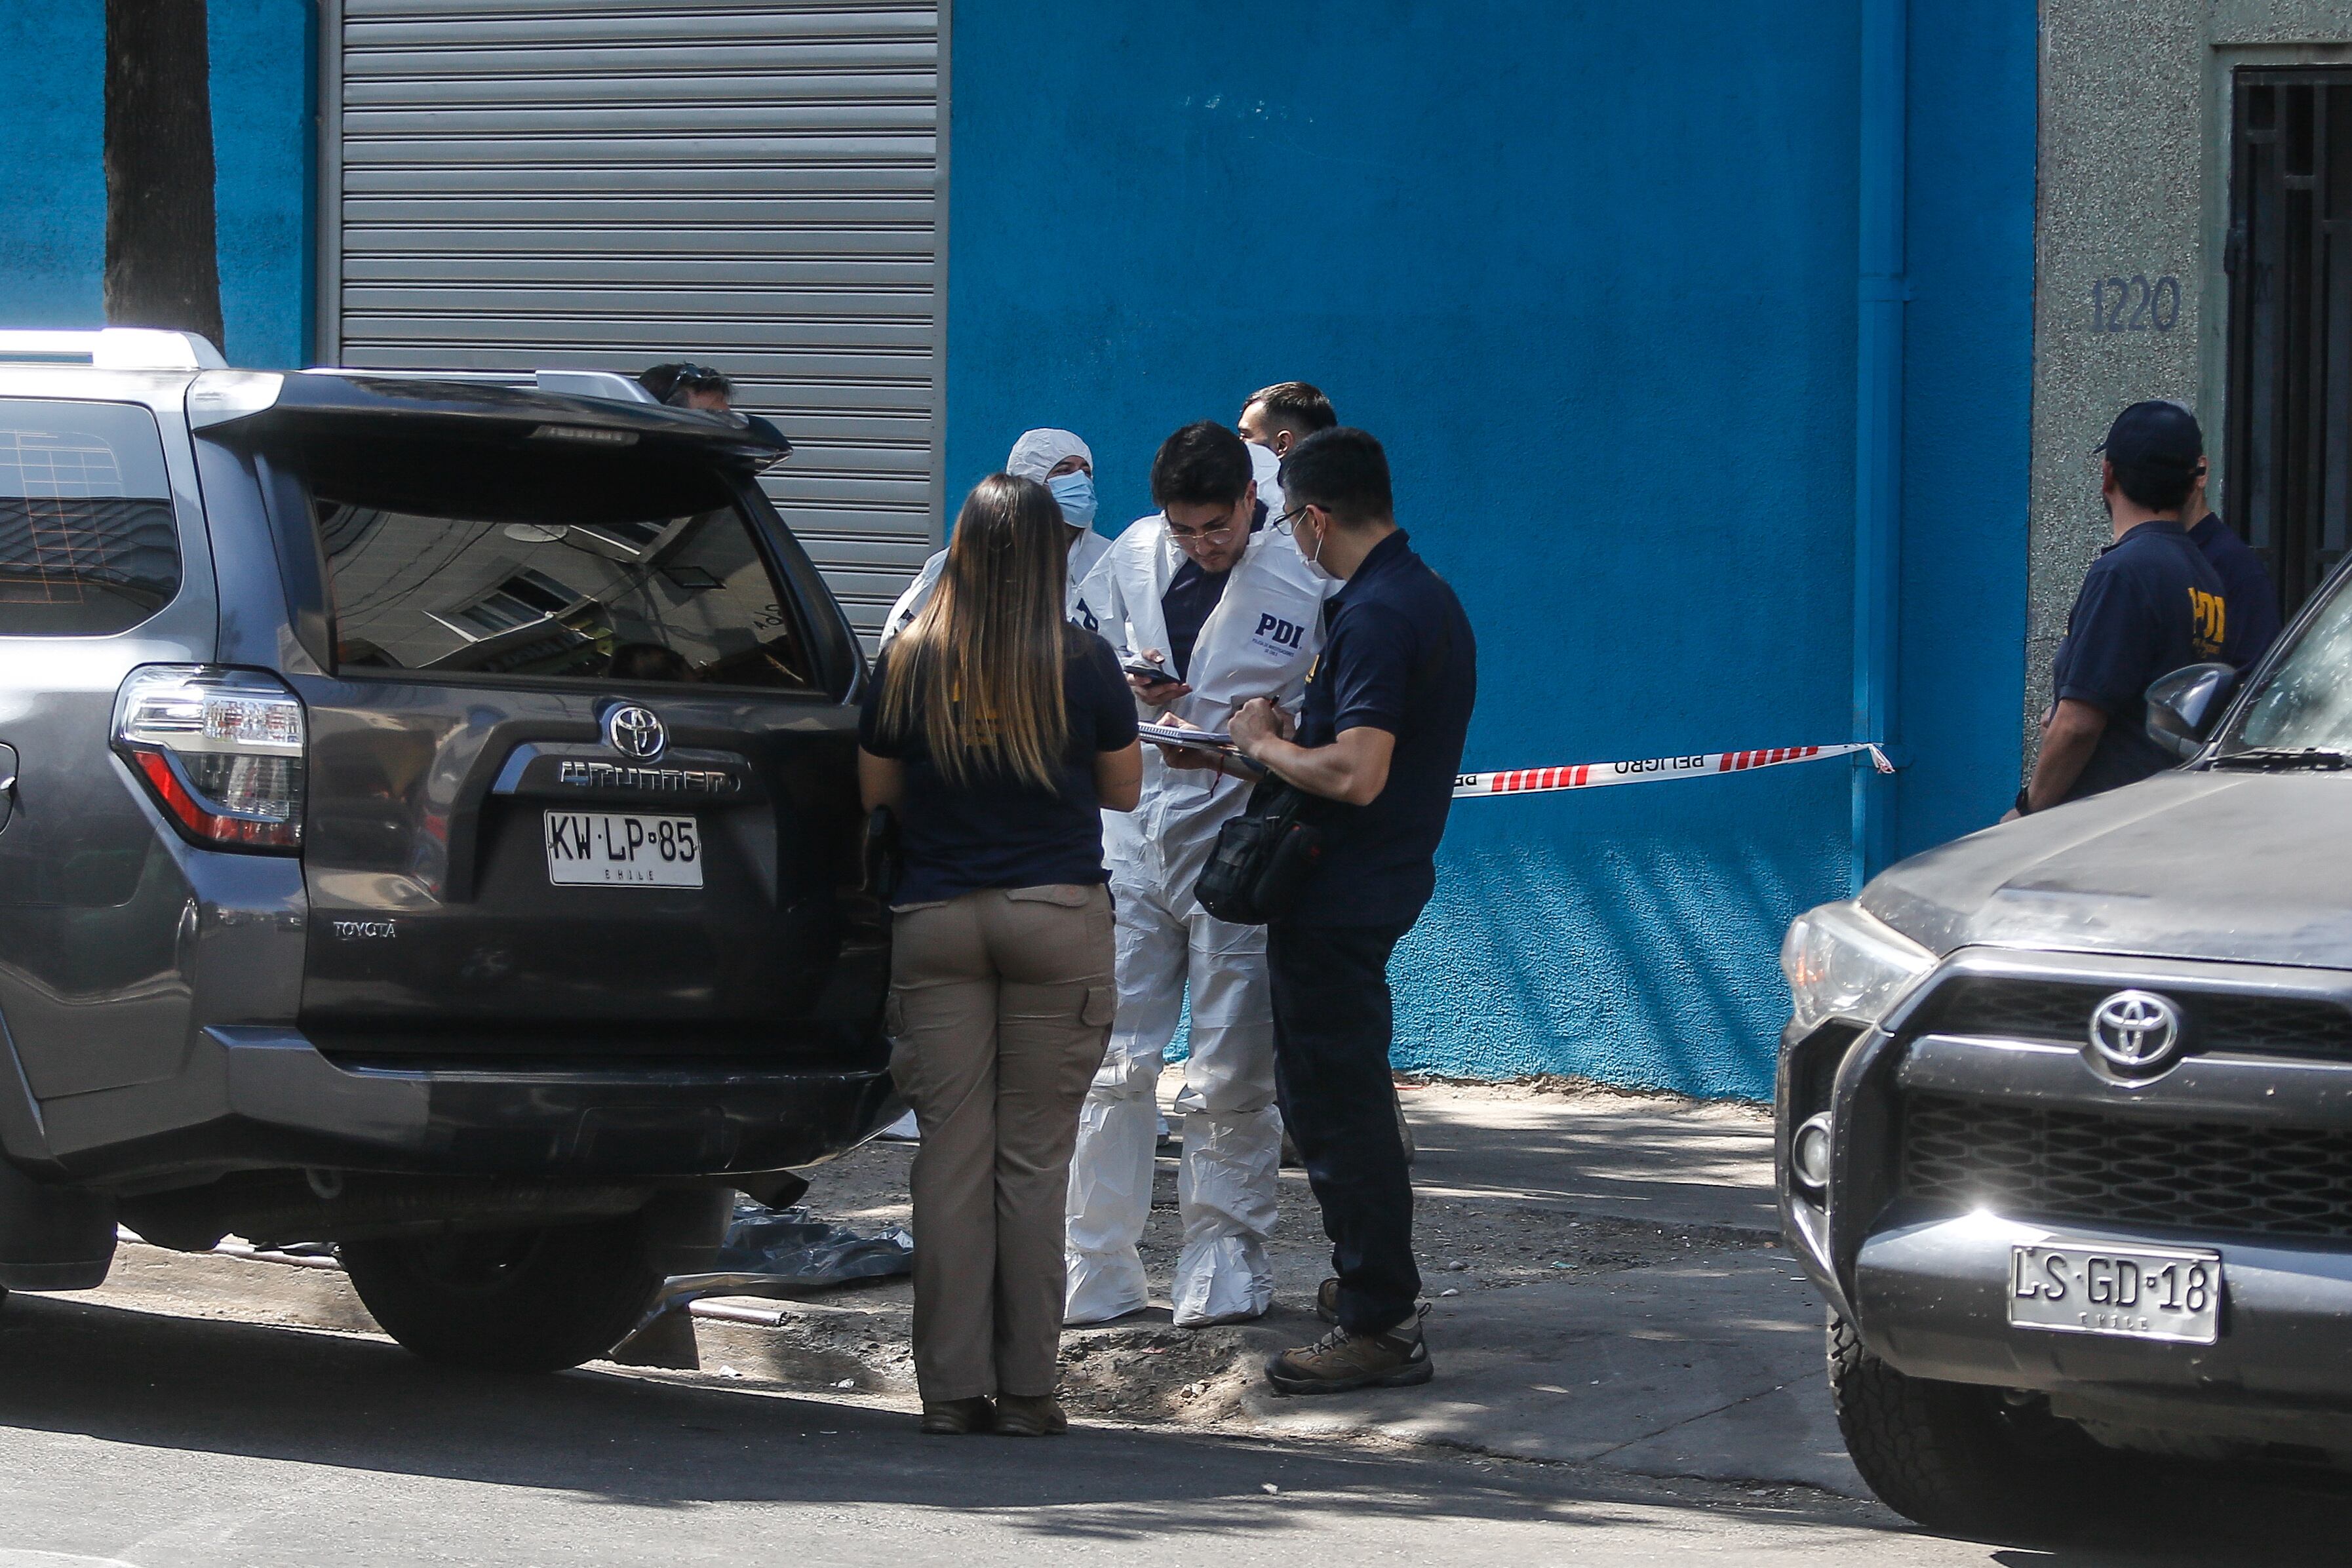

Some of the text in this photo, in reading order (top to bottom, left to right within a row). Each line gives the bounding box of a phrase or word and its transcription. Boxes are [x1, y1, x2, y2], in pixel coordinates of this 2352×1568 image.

[2088, 275, 2181, 332] 1220
[2187, 587, 2225, 643] DI
[1255, 612, 1305, 649] PDI
[1615, 755, 1704, 774] PELIGRO
[604, 870, 656, 880] CHILE
[333, 921, 396, 938] TOYOTA
